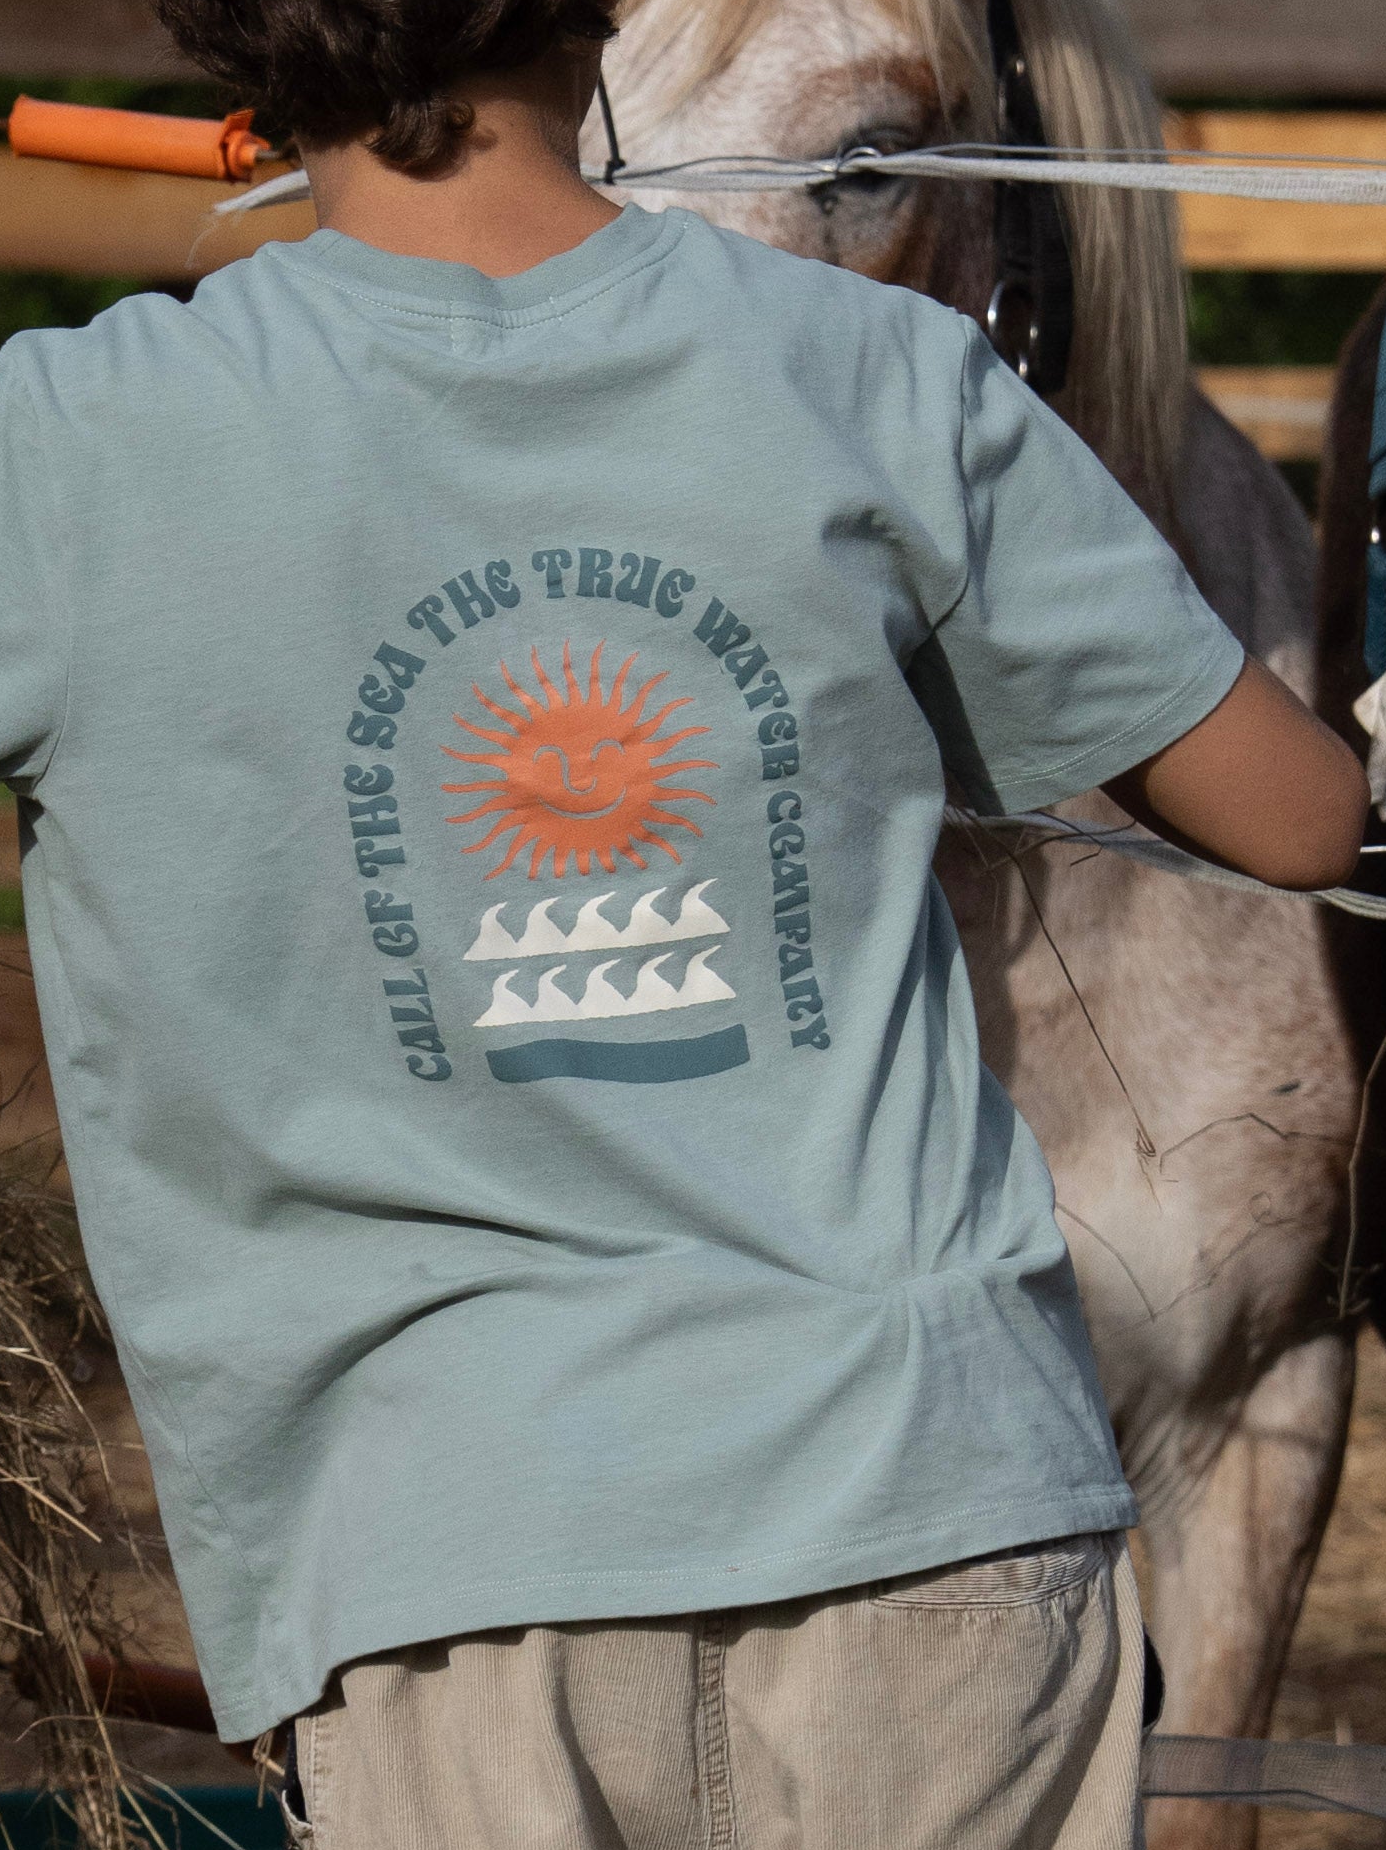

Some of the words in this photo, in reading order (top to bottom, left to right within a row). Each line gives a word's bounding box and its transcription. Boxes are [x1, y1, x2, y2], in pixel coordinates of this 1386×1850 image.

[407, 559, 521, 648] THE
[531, 547, 696, 618] TRUE
[346, 641, 427, 750] SEA
[693, 597, 800, 781] WATER
[343, 764, 407, 878] THE
[363, 889, 419, 958] OF
[766, 790, 831, 1051] COMPANY
[382, 968, 453, 1082] CALL
